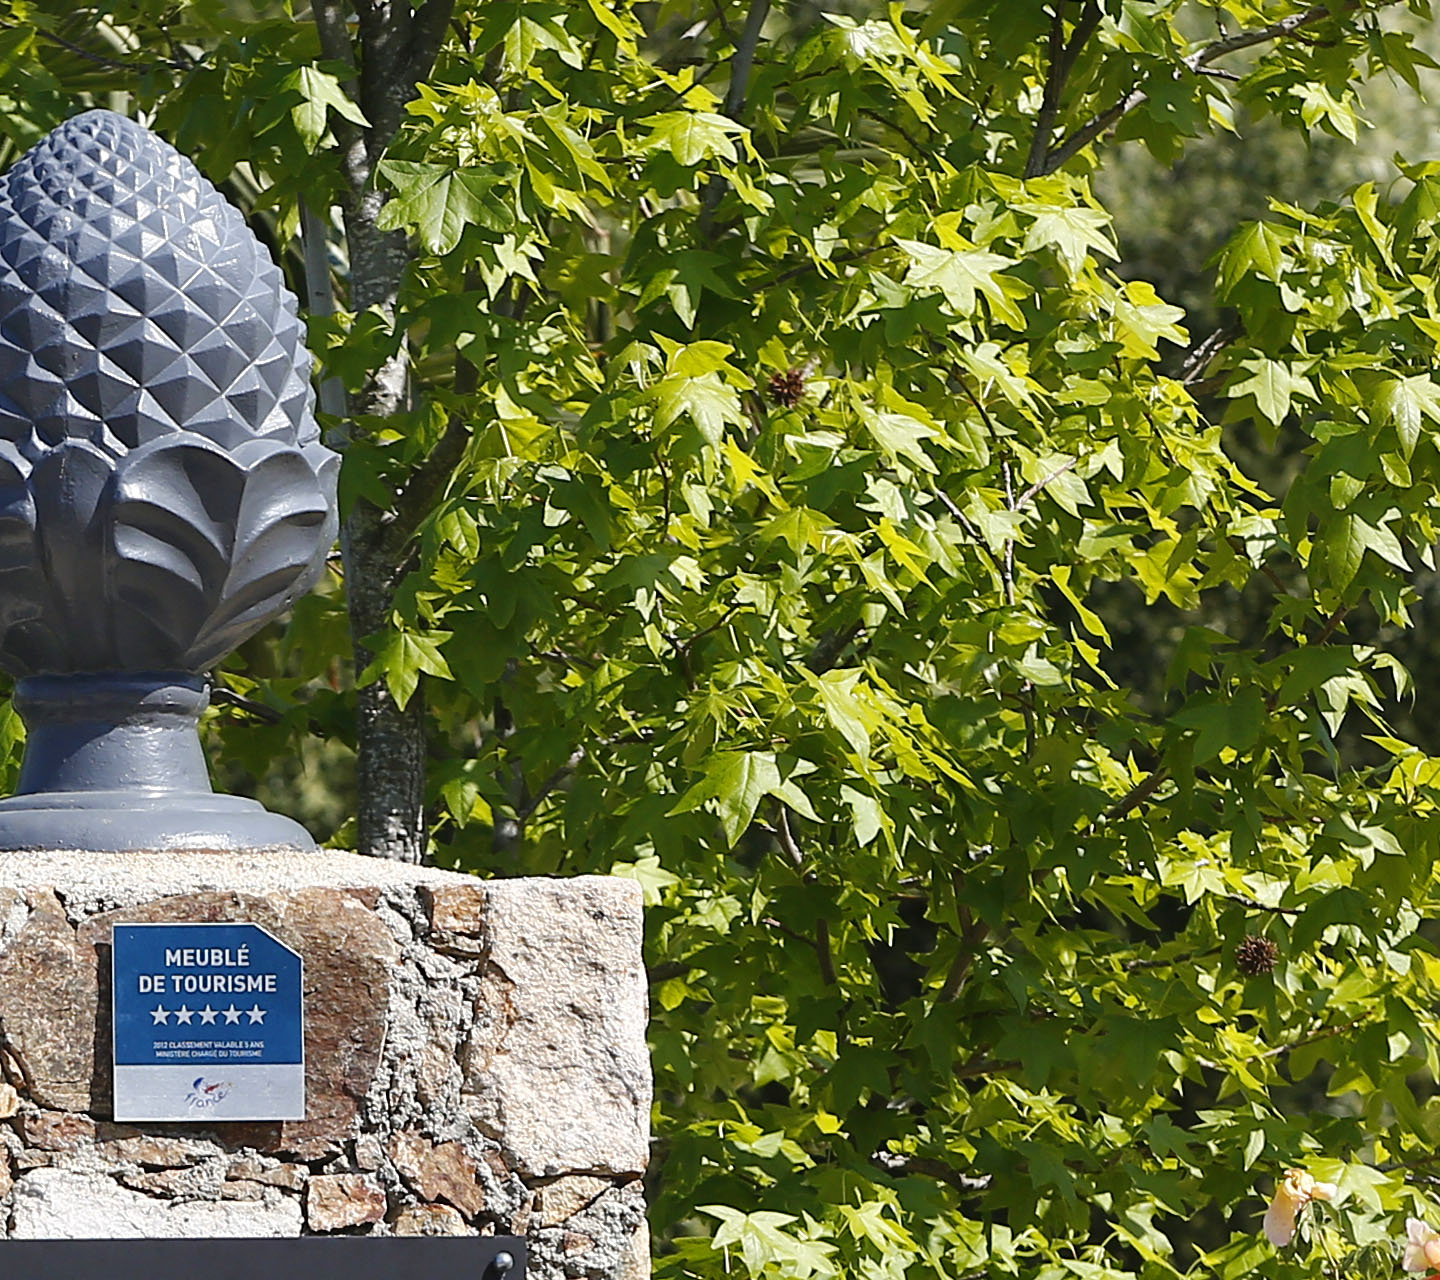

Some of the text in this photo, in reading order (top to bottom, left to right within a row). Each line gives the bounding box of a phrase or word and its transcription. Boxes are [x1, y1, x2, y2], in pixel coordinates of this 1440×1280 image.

[165, 943, 250, 967] MEUBLÉ
[139, 974, 277, 993] DE TOURISME
[169, 1041, 213, 1049] CLASSEMENT
[229, 1050, 263, 1058] TOURISME
